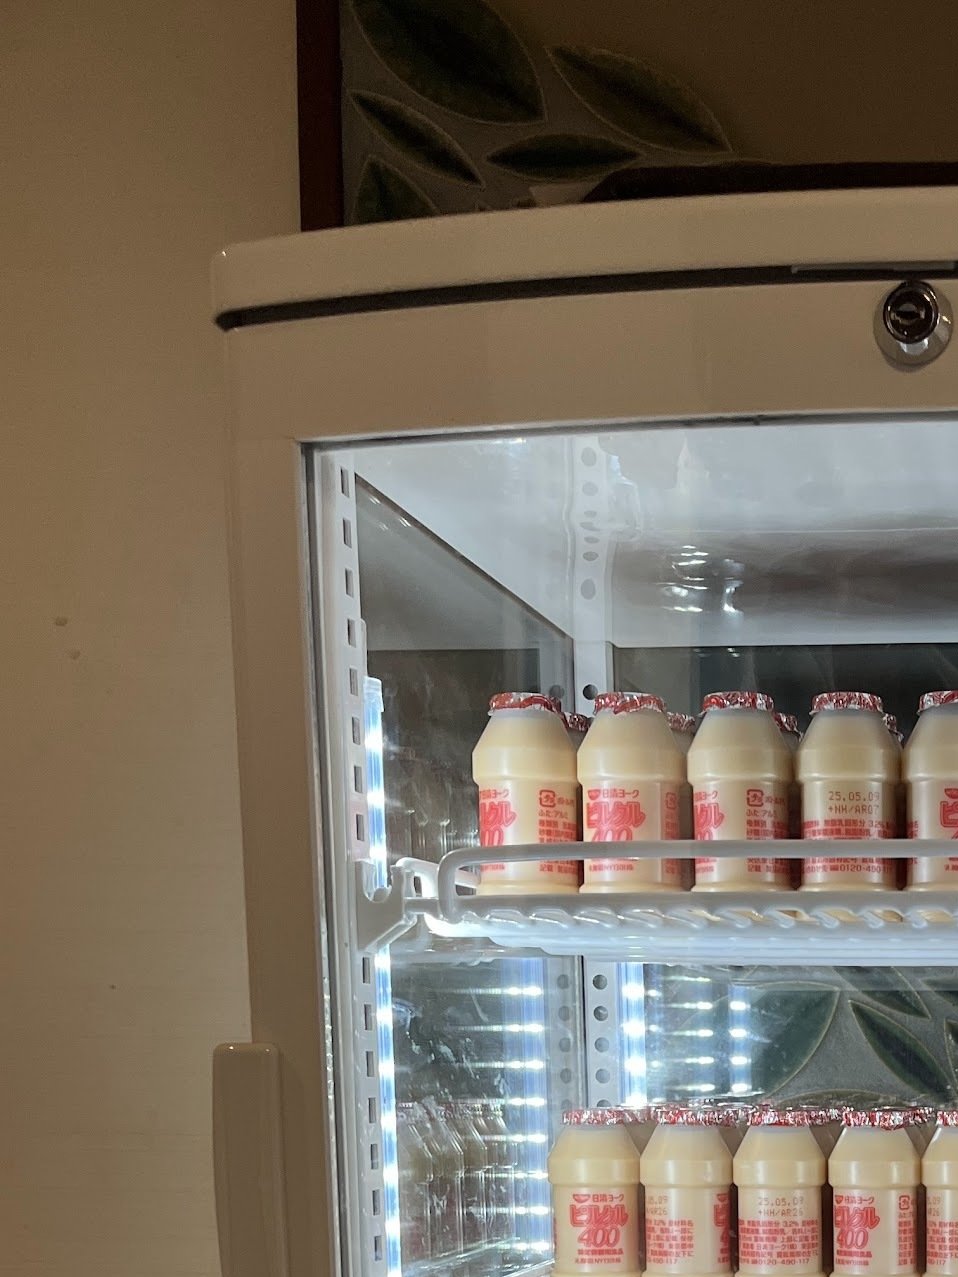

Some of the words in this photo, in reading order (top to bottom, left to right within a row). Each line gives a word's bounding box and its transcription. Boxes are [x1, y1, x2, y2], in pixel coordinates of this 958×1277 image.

[603, 789, 640, 799] 日清ヨーク
[828, 791, 881, 802] 25.05.09
[593, 1194, 624, 1202] 日清ヨーク
[570, 1204, 628, 1228] ピルクル
[578, 1227, 620, 1247] 400
